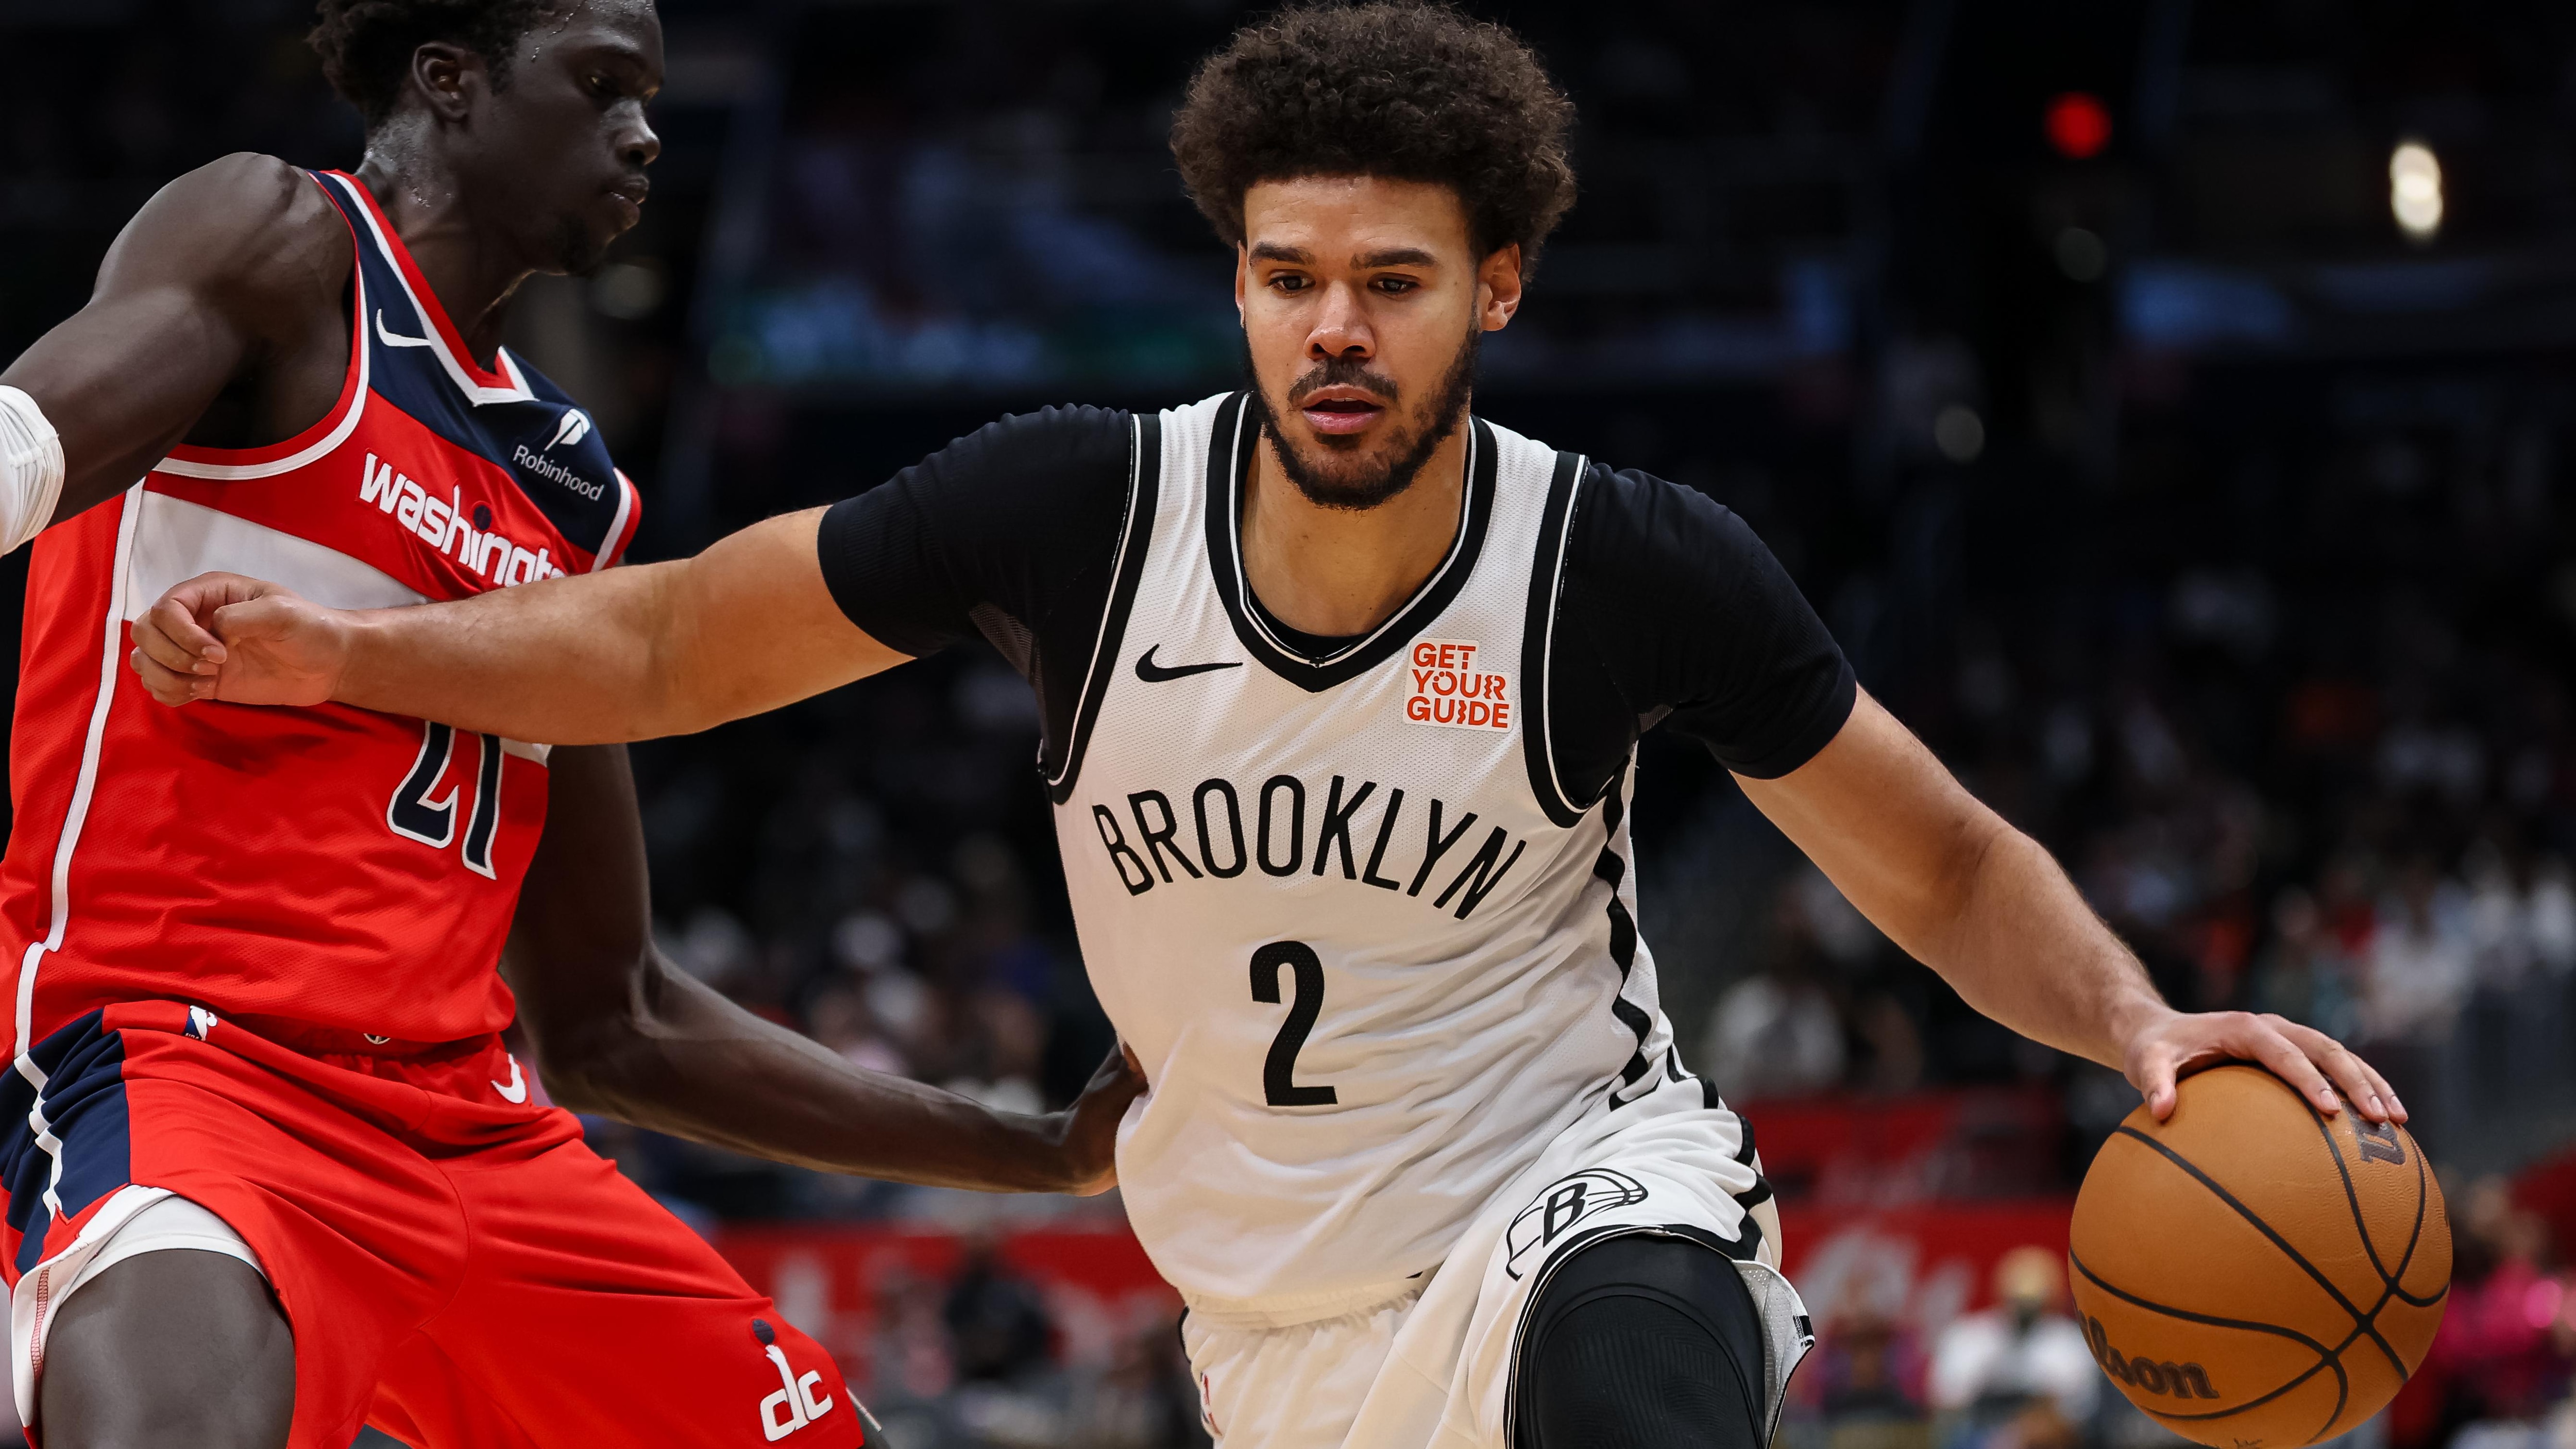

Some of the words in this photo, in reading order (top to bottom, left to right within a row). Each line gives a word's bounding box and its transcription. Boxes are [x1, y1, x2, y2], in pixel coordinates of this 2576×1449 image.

[513, 444, 604, 501] Robinhood
[1412, 669, 1506, 701] YOUR
[1413, 643, 1477, 670] GET
[1406, 696, 1510, 729] GUIDE
[386, 720, 504, 880] 21
[1092, 774, 1527, 921] BROOKLYN
[1249, 939, 1338, 1107] 2
